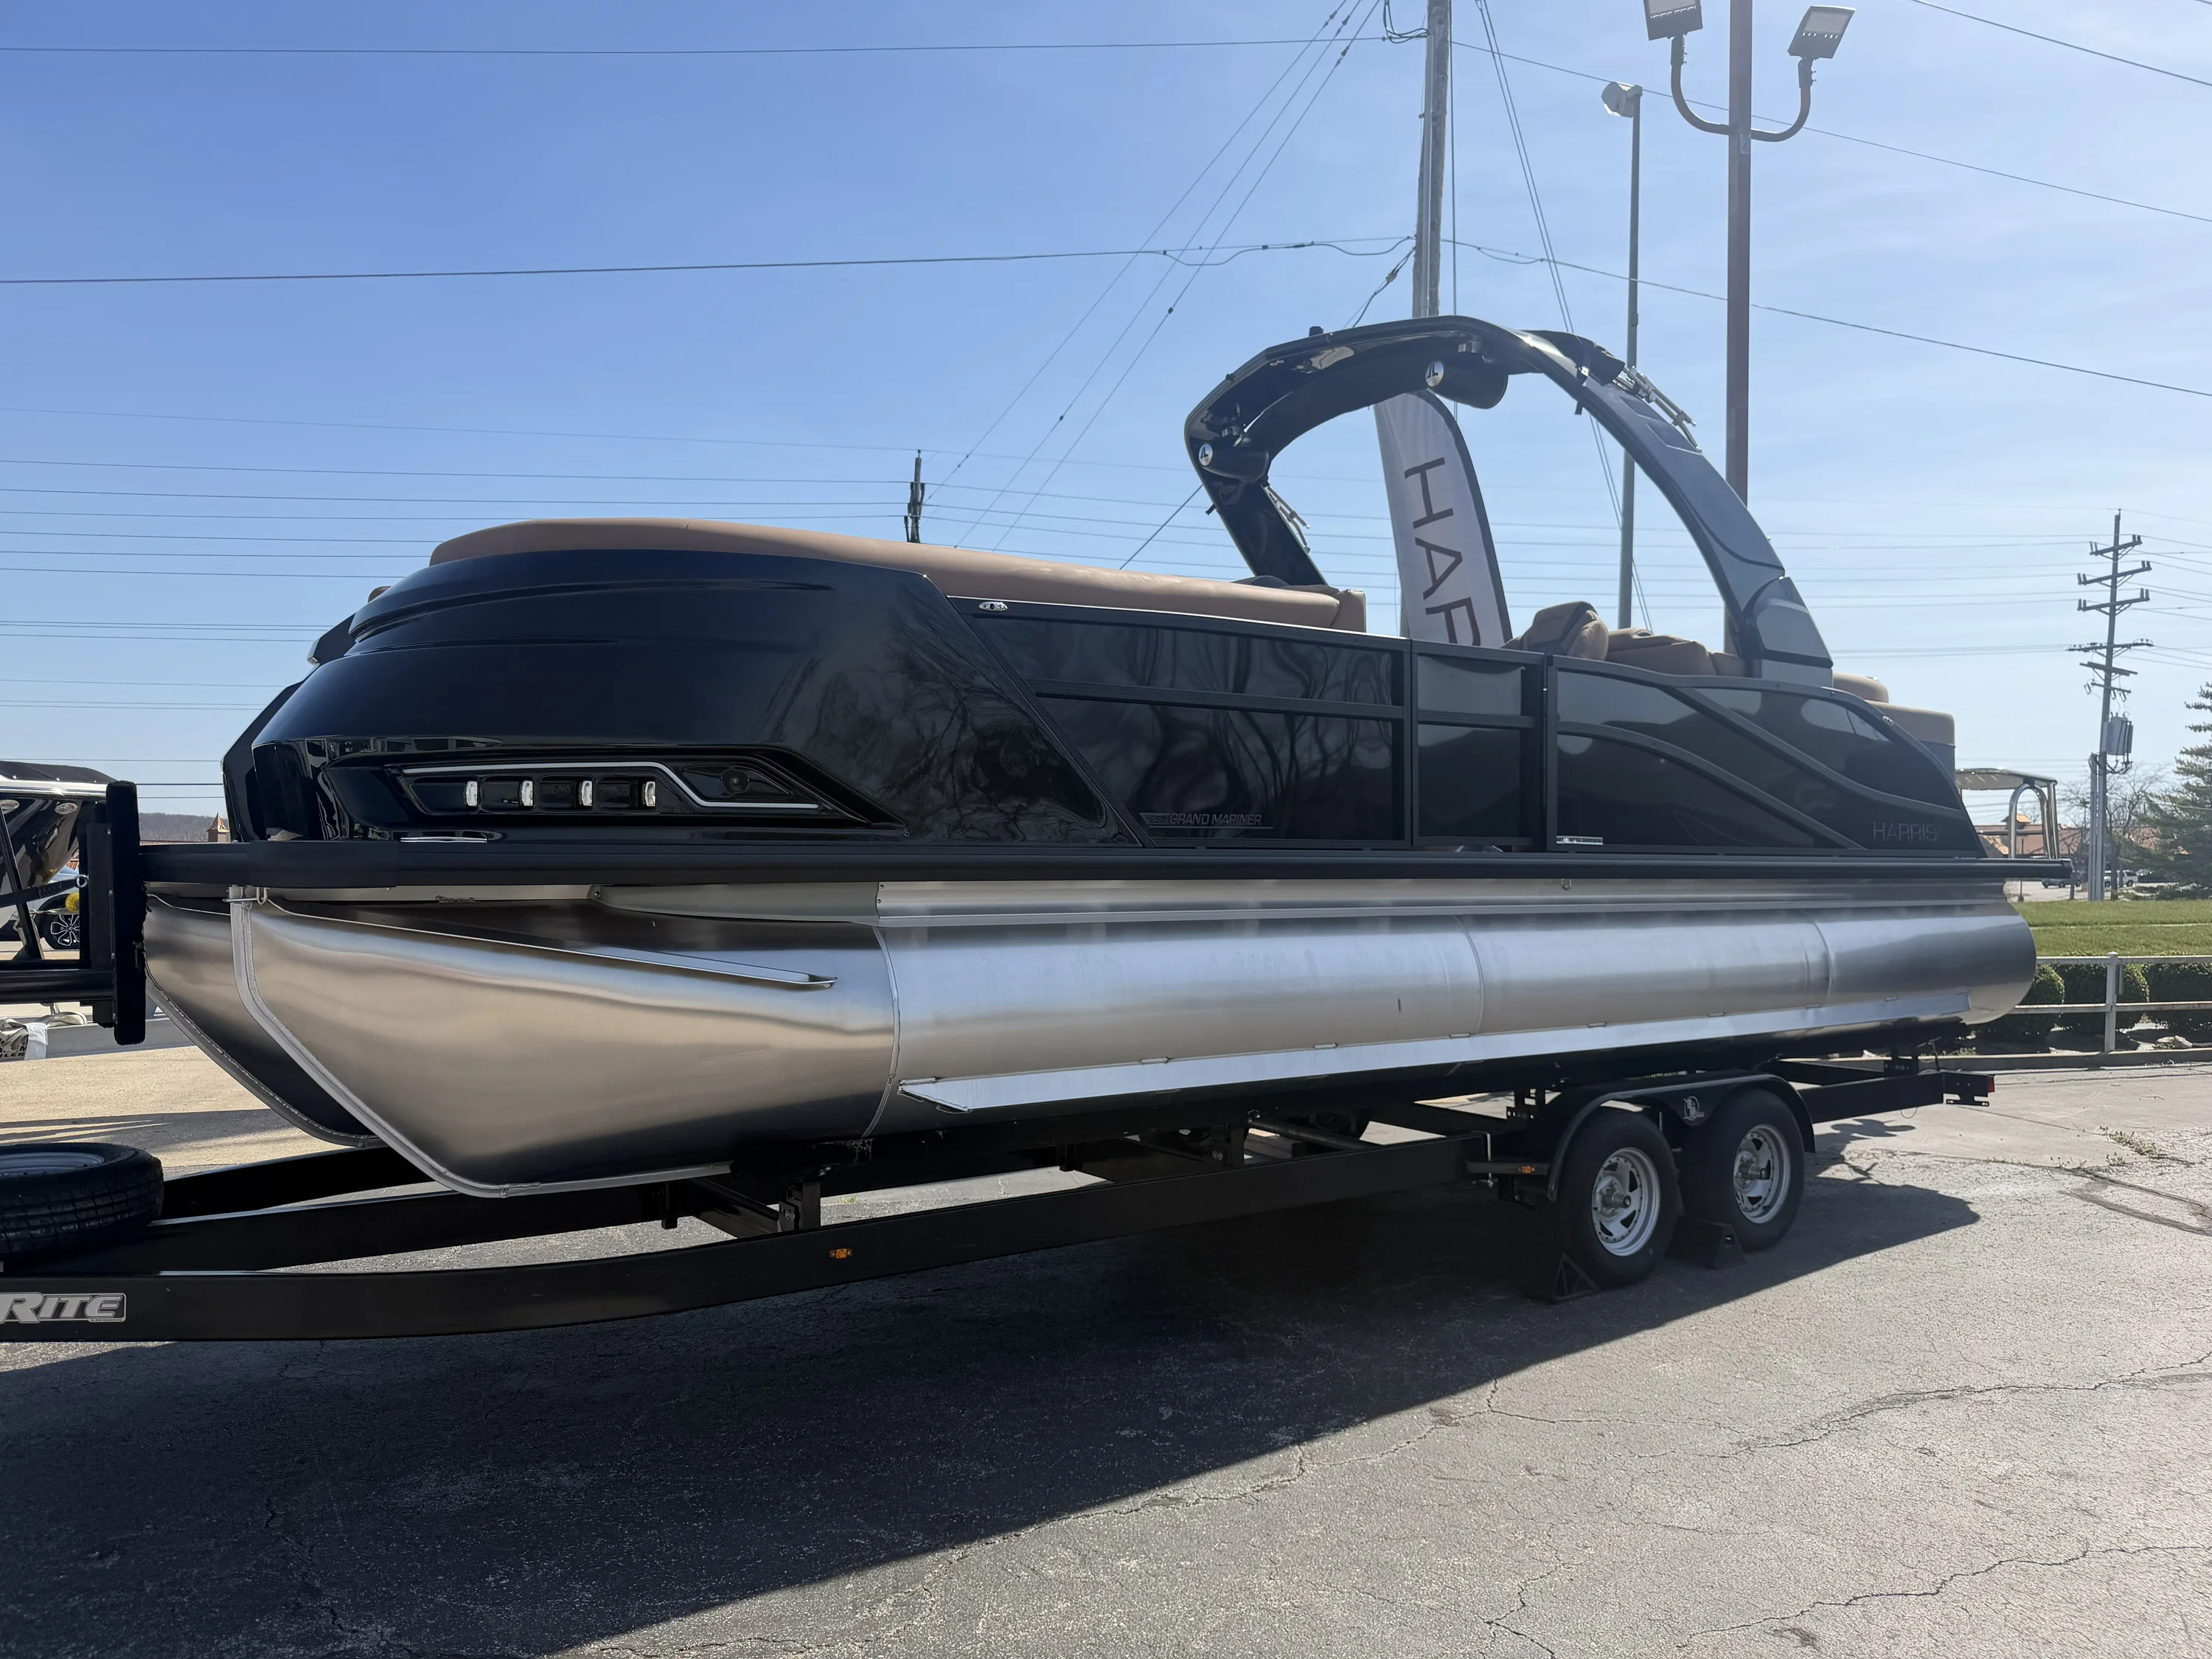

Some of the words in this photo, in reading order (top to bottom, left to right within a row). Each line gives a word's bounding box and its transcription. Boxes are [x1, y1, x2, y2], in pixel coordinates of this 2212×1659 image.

[1169, 813, 1210, 825] GRAND
[1211, 813, 1262, 826] MARINER
[1873, 821, 1937, 841] HARRIS
